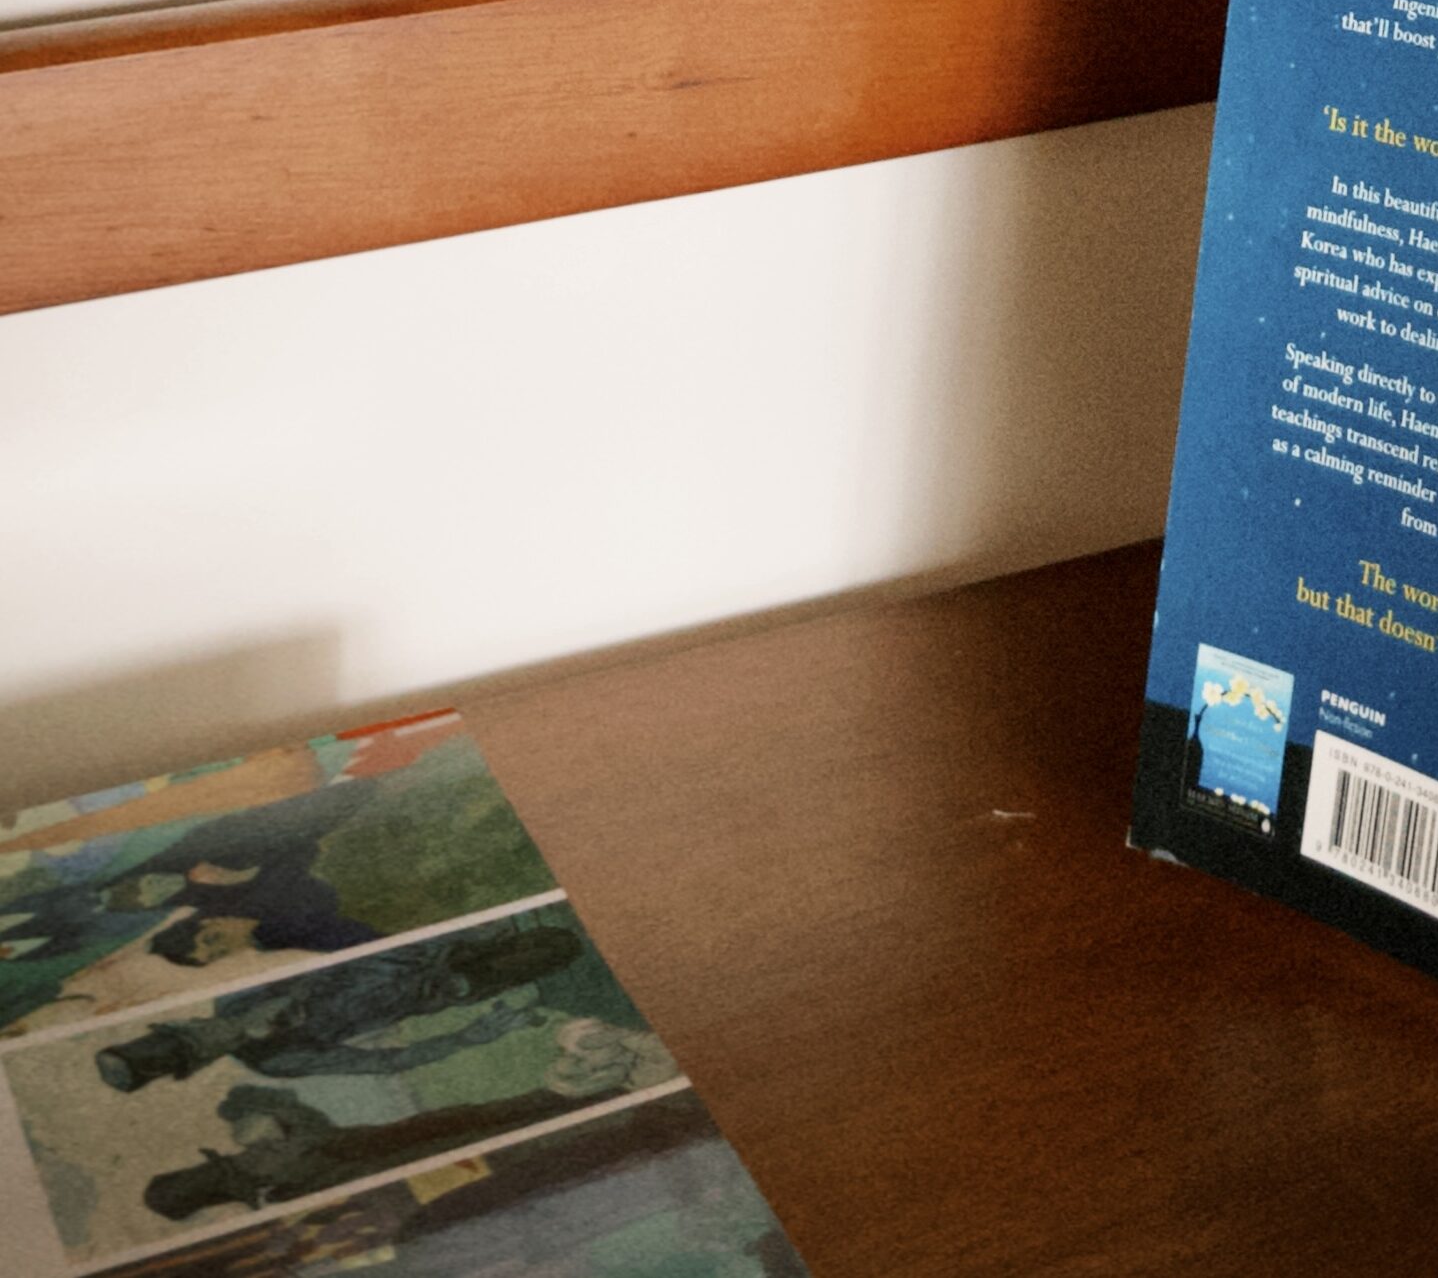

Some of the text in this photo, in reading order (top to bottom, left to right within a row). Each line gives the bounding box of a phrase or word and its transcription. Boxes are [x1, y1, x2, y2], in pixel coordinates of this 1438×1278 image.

[1392, 21, 1437, 50] boost
[1351, 114, 1369, 139] it
[1373, 117, 1407, 148] the
[1352, 180, 1381, 205] this
[1305, 205, 1405, 247] mindfulness,
[1300, 229, 1348, 260] Korea
[1351, 246, 1386, 270] who
[1387, 252, 1414, 278] has
[1293, 265, 1360, 295] spiritual
[1361, 280, 1411, 310] advice
[1336, 307, 1377, 332] work
[1284, 342, 1355, 385] Speaking
[1356, 362, 1417, 404] directly
[1302, 383, 1364, 414] modern
[1366, 397, 1397, 428] life,
[1358, 559, 1397, 596] The
[1295, 576, 1331, 612] but
[1335, 592, 1375, 629] that
[1320, 688, 1387, 727] PENGUIN
